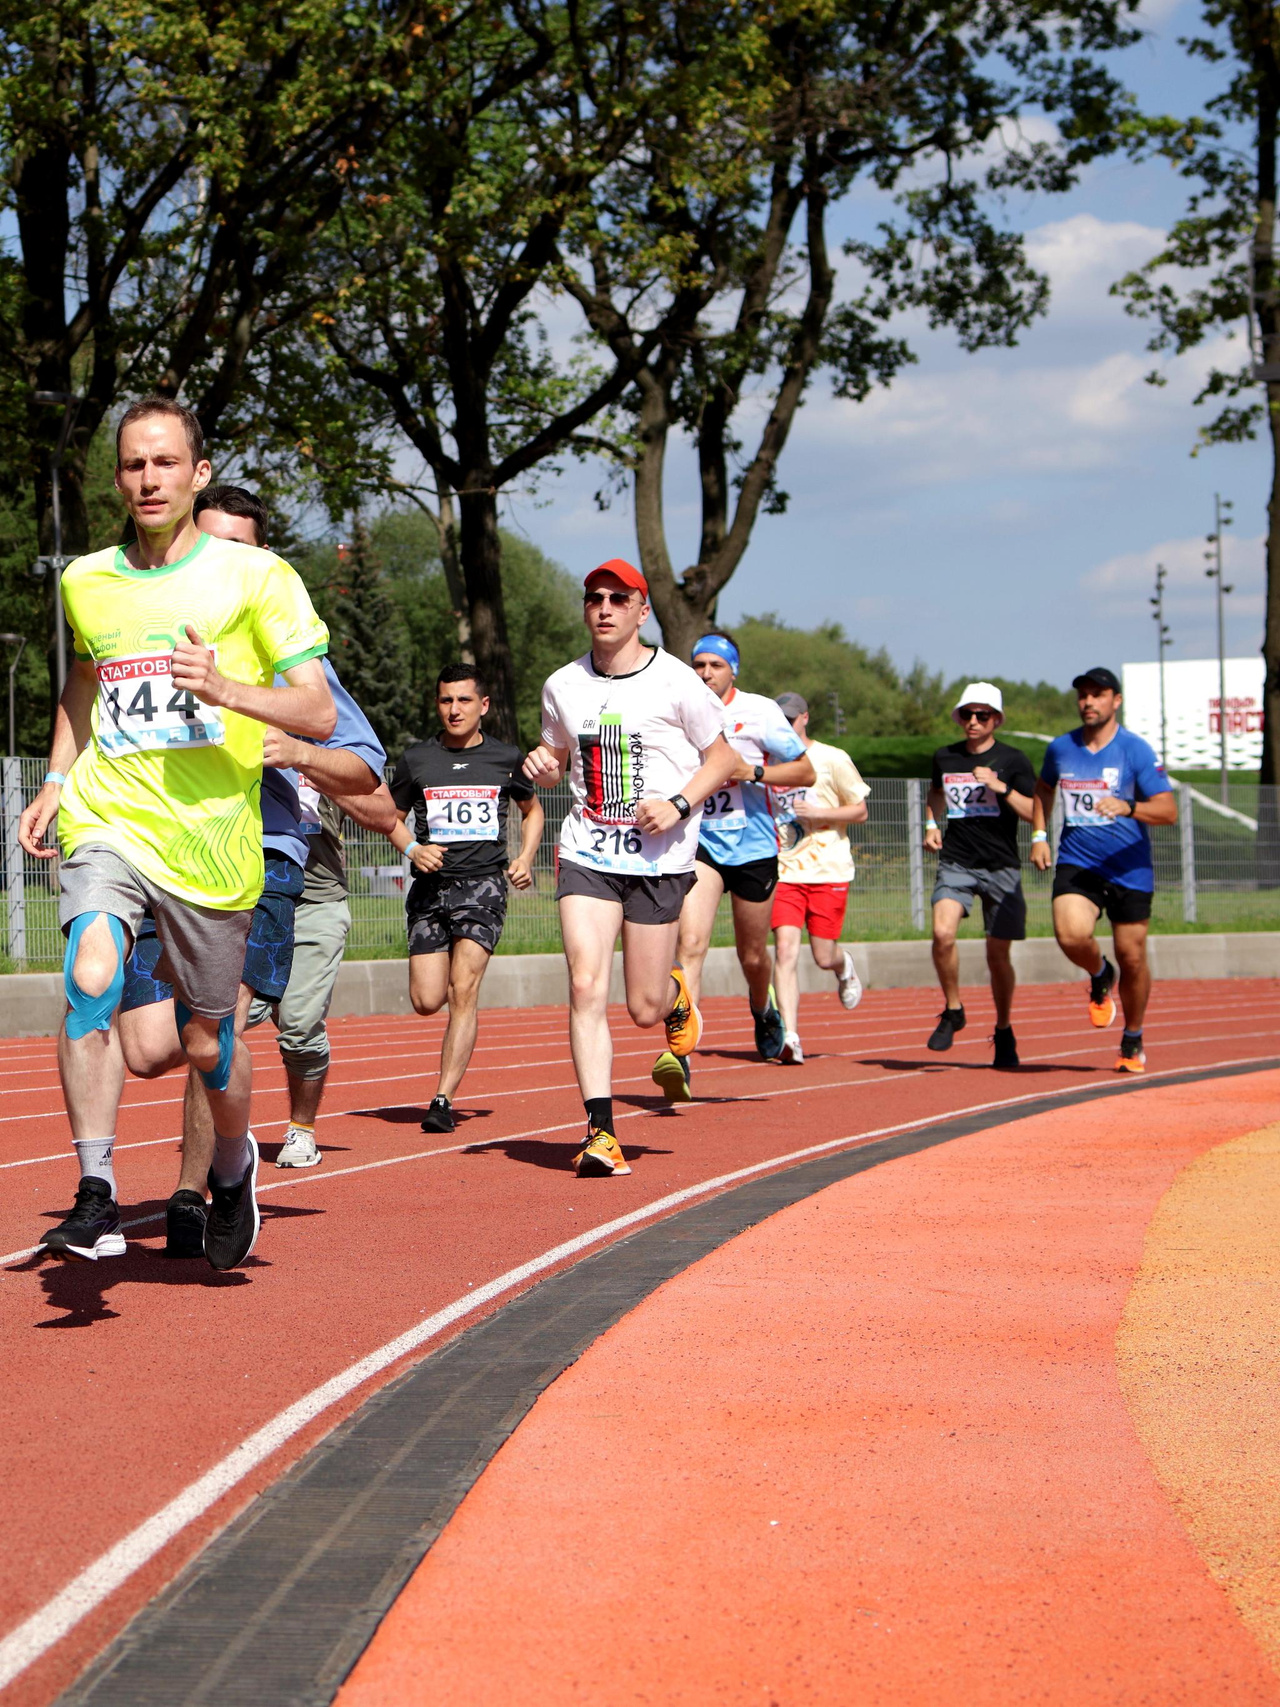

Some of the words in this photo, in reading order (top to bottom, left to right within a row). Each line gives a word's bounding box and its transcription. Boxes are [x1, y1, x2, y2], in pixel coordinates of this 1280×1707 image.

[106, 680, 201, 726] 144
[431, 789, 492, 799] СТАРТОВЫЙ
[949, 785, 988, 804] 322
[1070, 792, 1095, 811] 79
[441, 801, 492, 825] 163
[590, 828, 643, 856] 216
